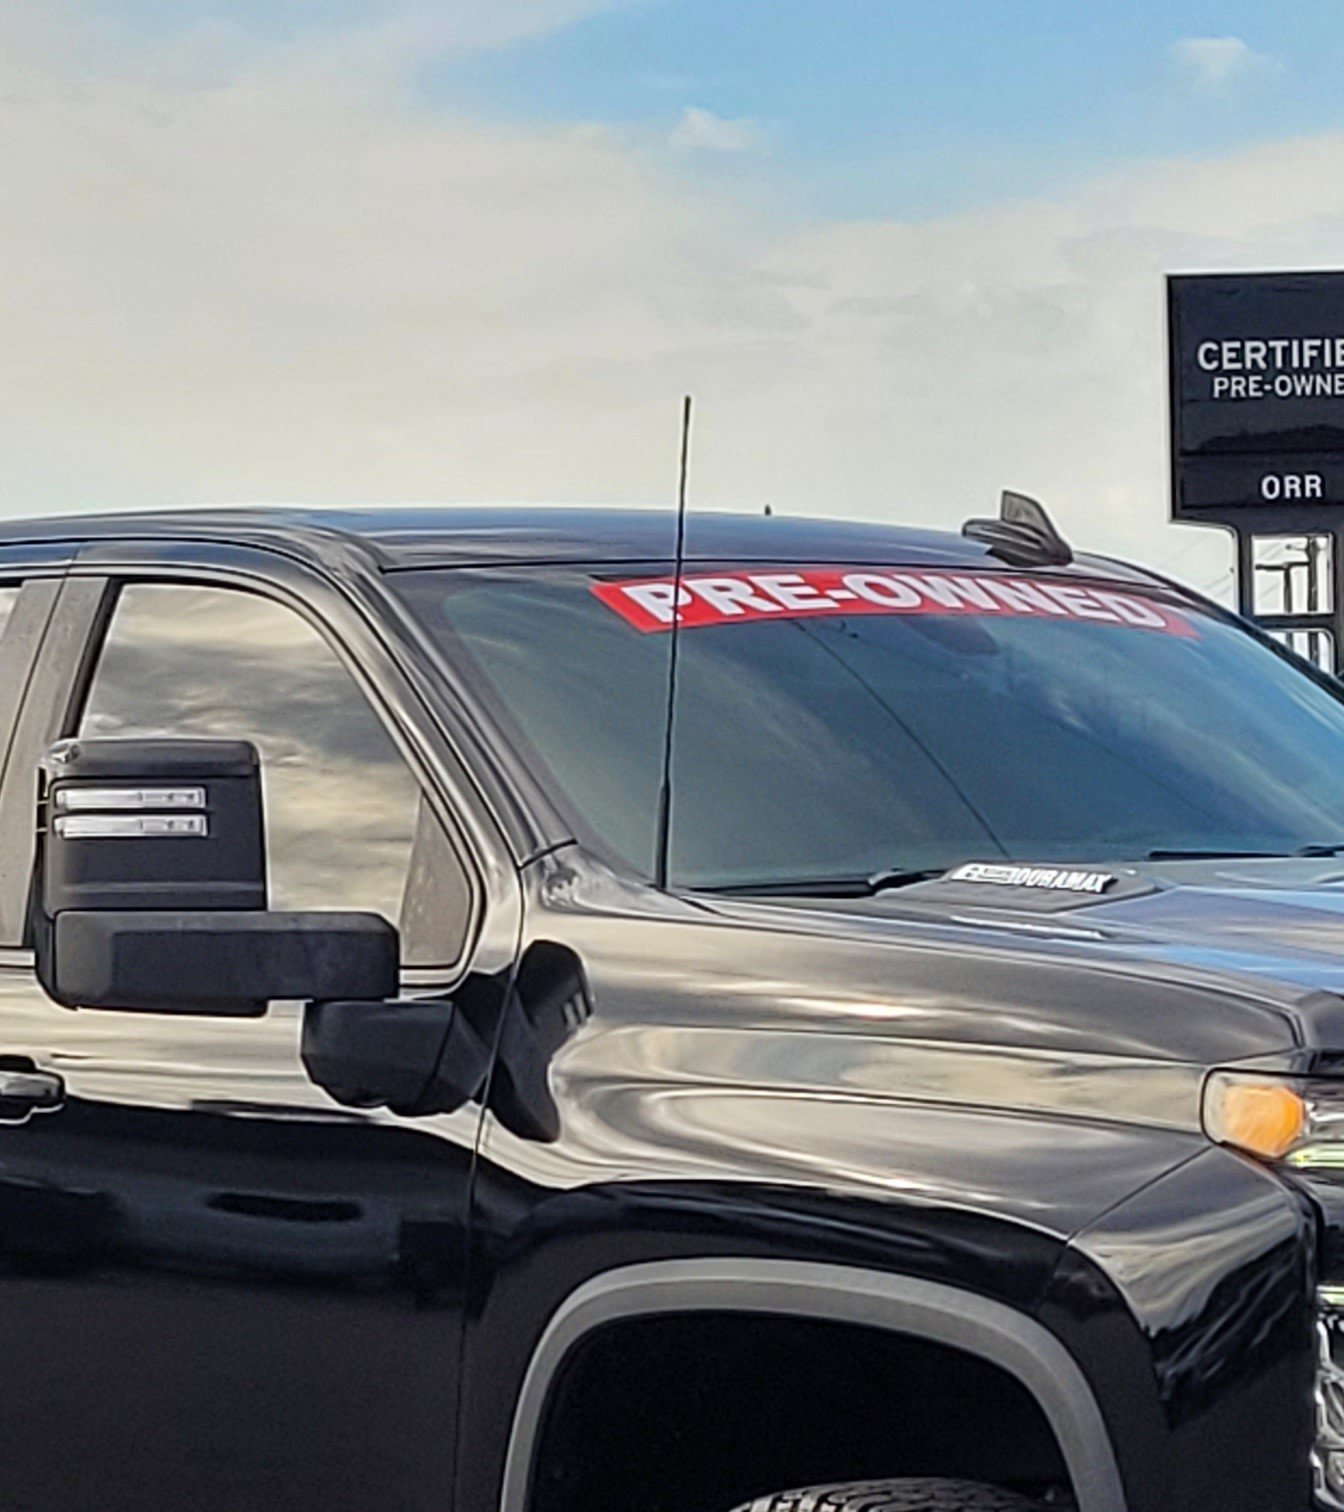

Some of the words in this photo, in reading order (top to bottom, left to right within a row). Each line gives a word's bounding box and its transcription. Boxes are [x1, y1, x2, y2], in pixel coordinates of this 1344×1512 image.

[1261, 475, 1323, 500] ORR
[621, 573, 1169, 628] PRE-OWNED
[1013, 867, 1112, 892] DURAMAX
